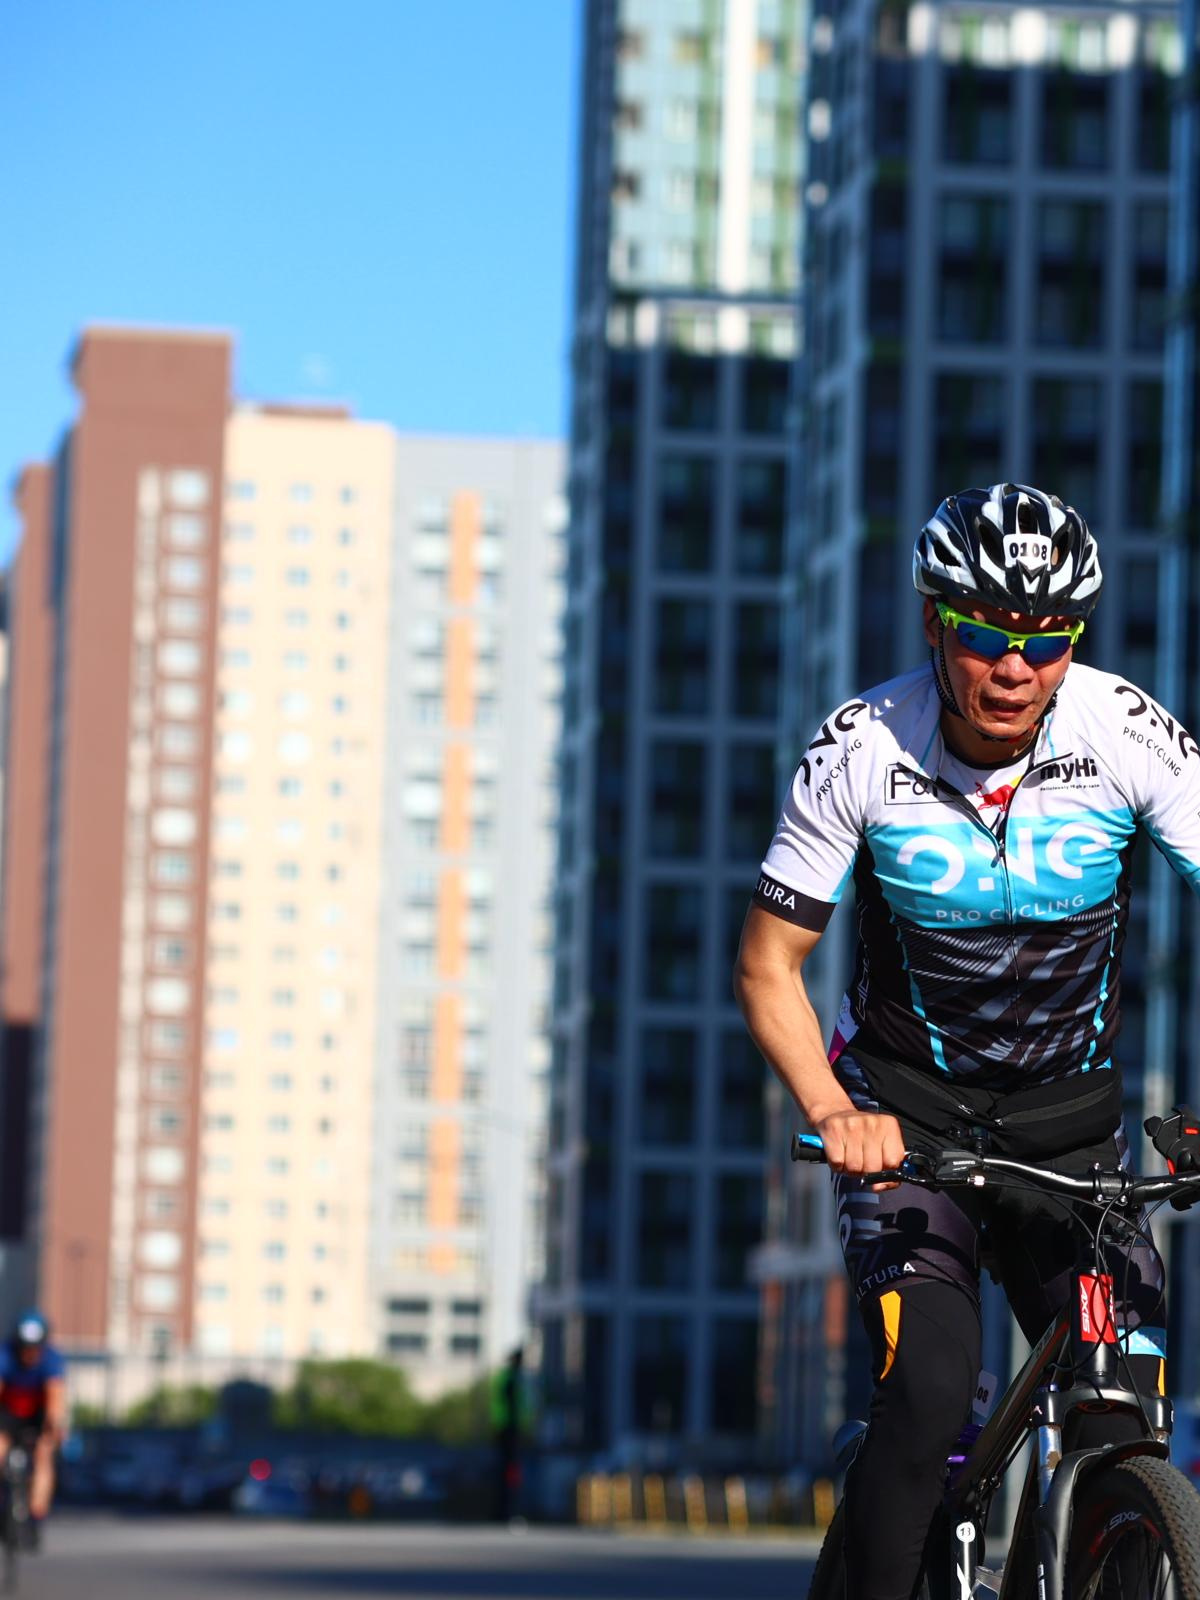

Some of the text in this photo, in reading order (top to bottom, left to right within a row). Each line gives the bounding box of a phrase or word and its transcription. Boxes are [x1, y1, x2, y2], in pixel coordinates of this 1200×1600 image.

[1123, 726, 1181, 777] PRO CYCLING
[1040, 757, 1098, 783] myHi
[816, 778, 832, 802] PRO
[936, 894, 1086, 922] PRO CYCLING
